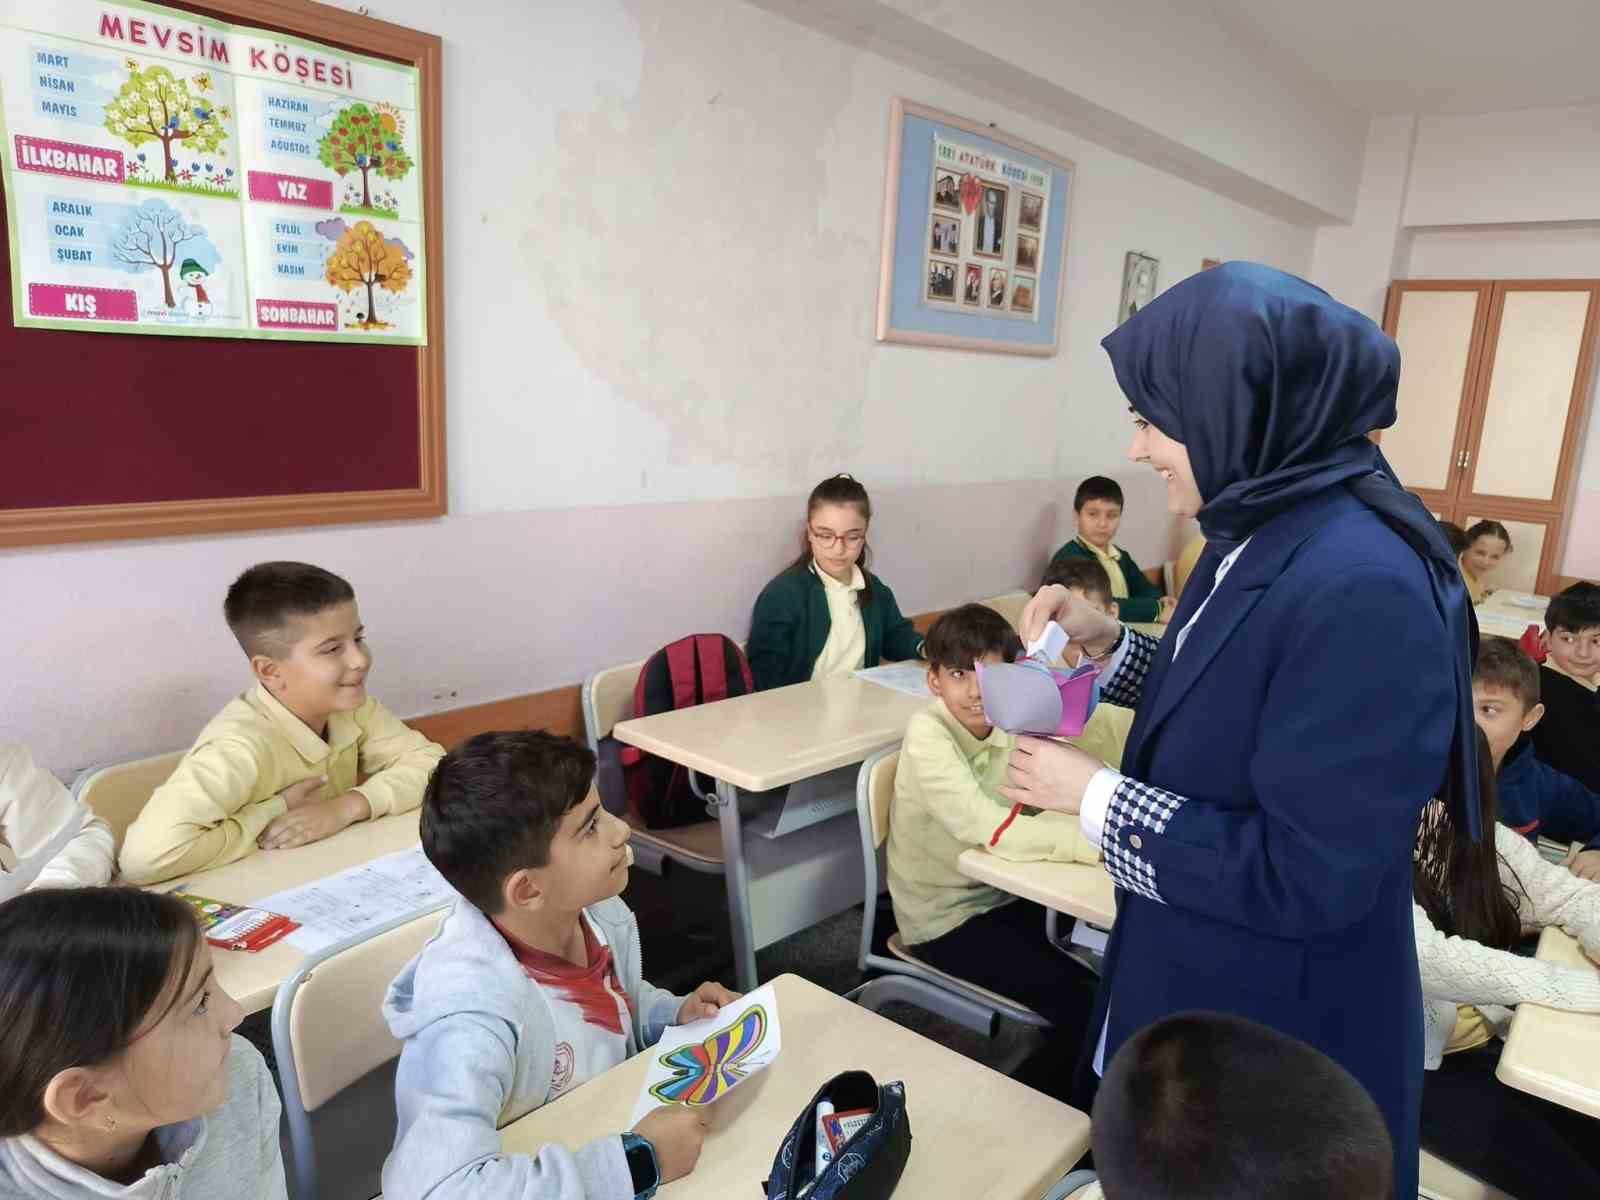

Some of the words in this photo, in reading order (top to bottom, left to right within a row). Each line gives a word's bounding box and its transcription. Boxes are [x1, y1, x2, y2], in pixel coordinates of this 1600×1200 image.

[100, 14, 229, 64] MEVSİM
[250, 44, 353, 89] KÖŞESİ
[37, 52, 69, 68] MART
[39, 74, 75, 92] NİSAN
[41, 101, 78, 116] MAYIS
[268, 96, 309, 113] HAZİRAN
[269, 118, 306, 132] TEMMUZ
[271, 137, 311, 155] AĞUSTOS
[21, 139, 119, 178] İLKBAHAR
[278, 180, 308, 200] YAZ
[52, 201, 93, 217] ARALIK
[55, 224, 85, 238] OCAK
[276, 223, 301, 235] EYLÜL
[56, 247, 93, 262] ŞUBAT
[276, 242, 299, 254] EKİM
[278, 264, 304, 275] KASIM
[64, 292, 97, 318] KIŞ
[261, 307, 335, 325] SONBAHAR
